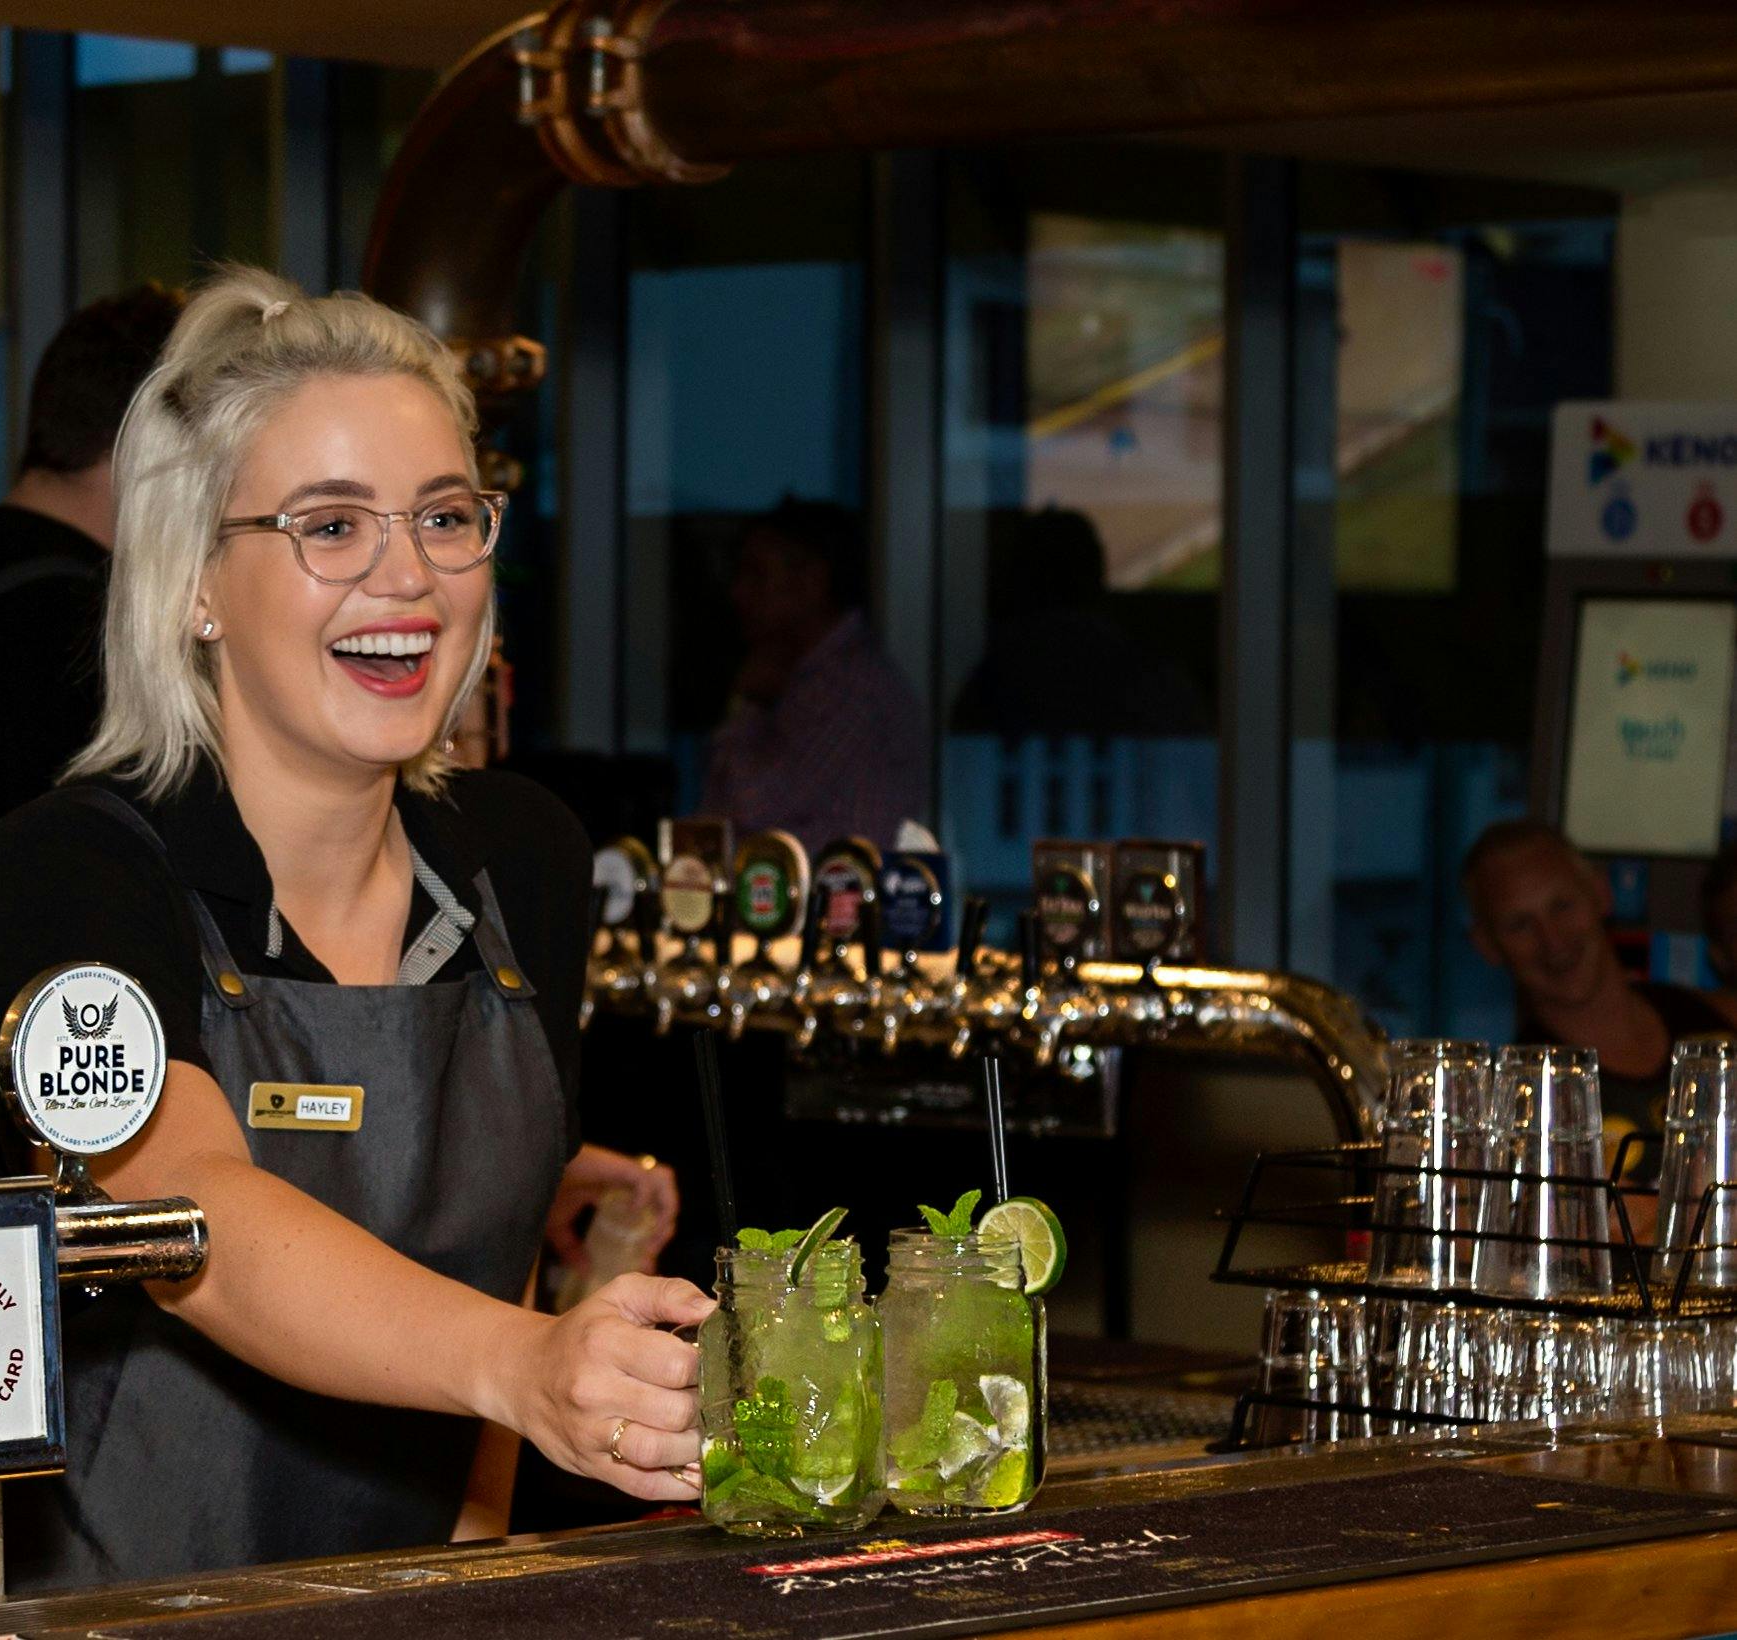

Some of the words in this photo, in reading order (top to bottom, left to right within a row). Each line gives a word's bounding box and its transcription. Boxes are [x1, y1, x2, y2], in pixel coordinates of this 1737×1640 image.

[59, 1044, 125, 1070] PURE
[39, 1069, 144, 1097] BLONDE
[301, 1102, 347, 1115] HAYLEY
